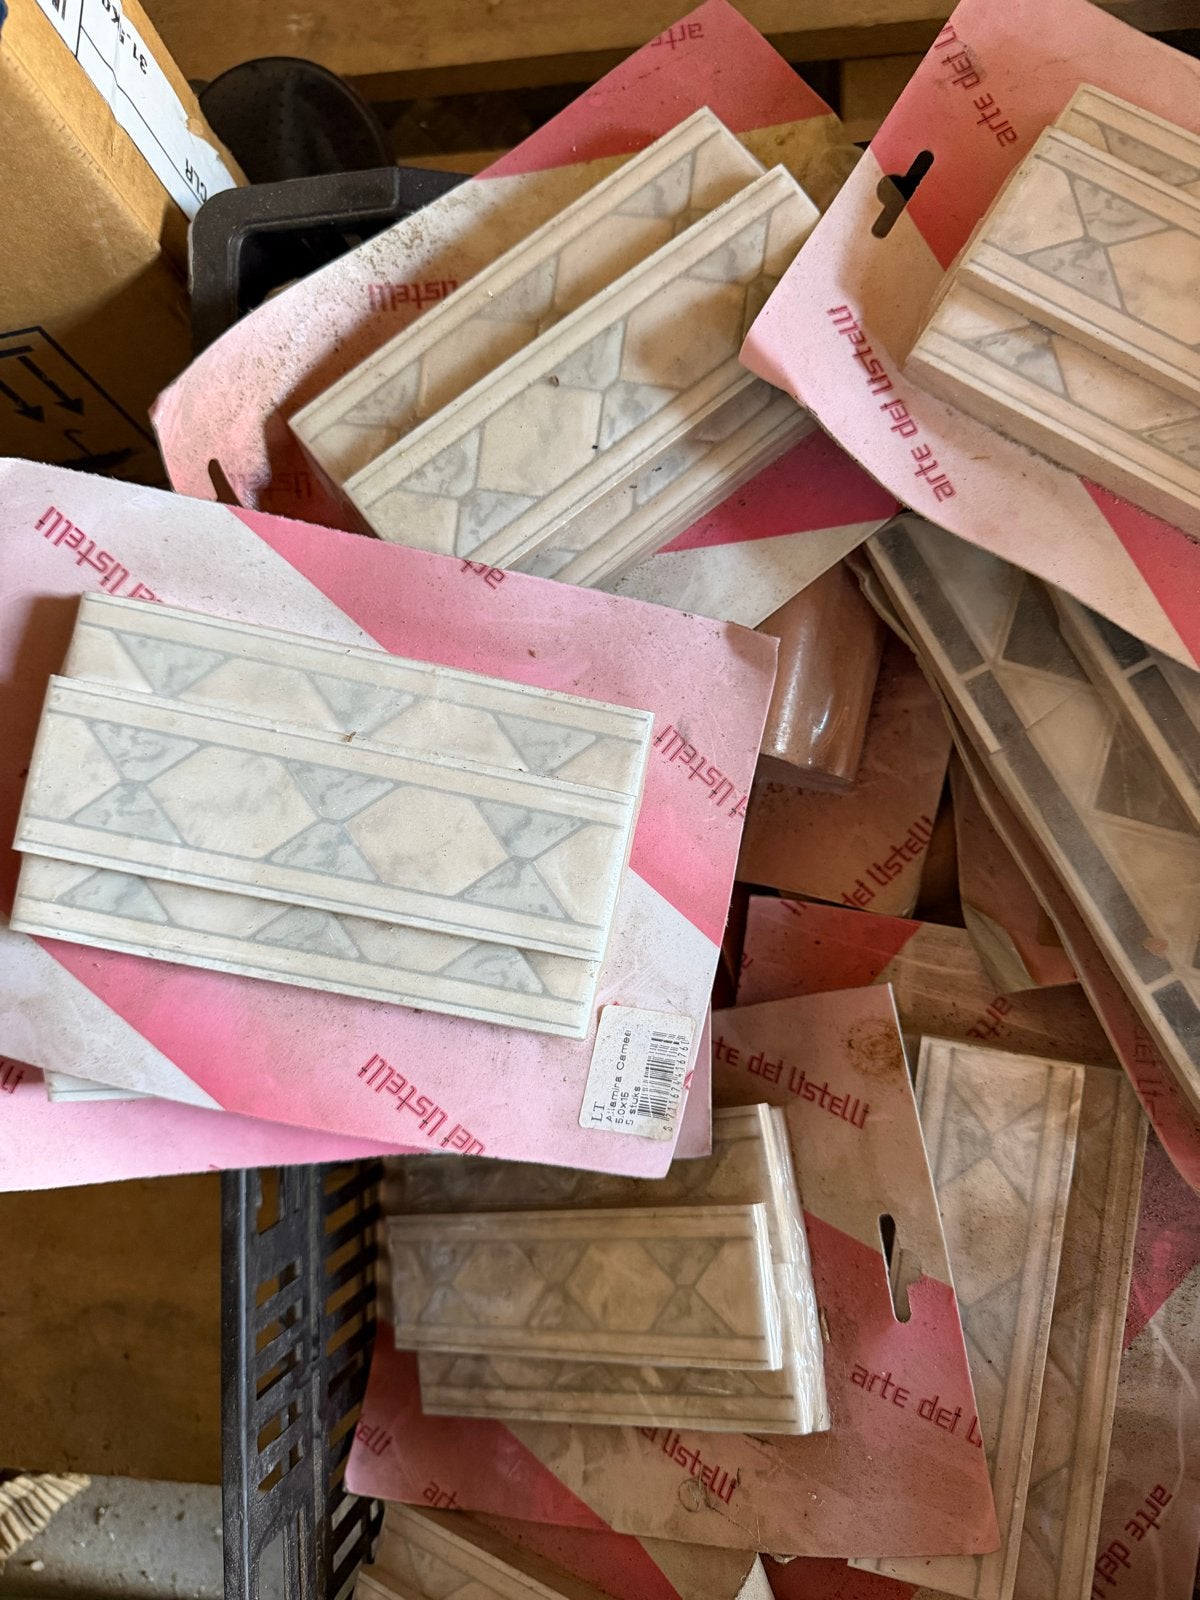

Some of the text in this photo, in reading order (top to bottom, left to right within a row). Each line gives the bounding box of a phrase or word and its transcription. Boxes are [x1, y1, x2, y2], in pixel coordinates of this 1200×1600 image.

[973, 93, 1018, 147] arte
[910, 443, 957, 502] arte
[629, 1086, 641, 1114] stuks
[851, 1363, 910, 1408] arte
[1124, 1484, 1173, 1541] arte
